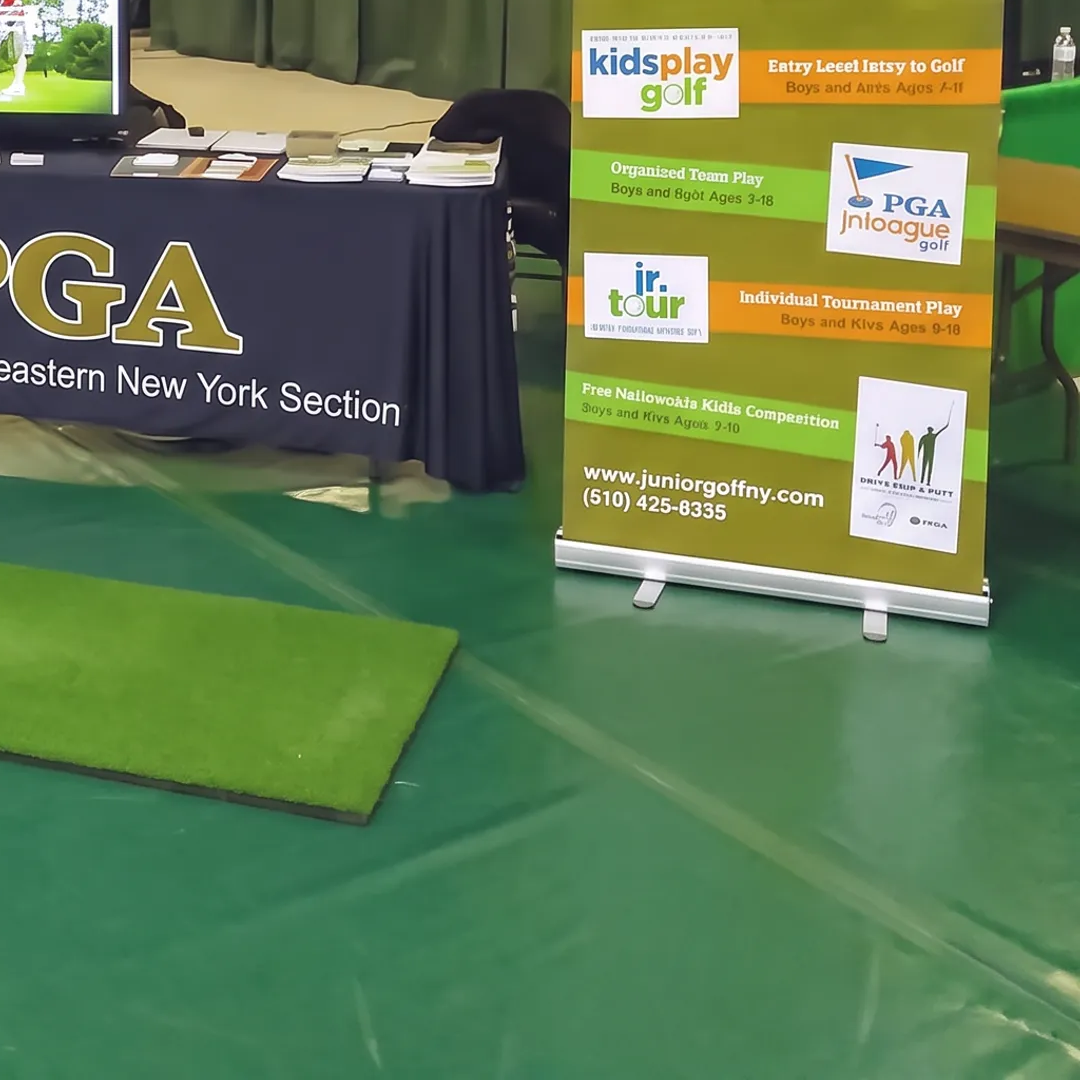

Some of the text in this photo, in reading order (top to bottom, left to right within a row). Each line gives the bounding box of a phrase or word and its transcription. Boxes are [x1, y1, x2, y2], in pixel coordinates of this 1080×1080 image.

[589, 46, 734, 82] kidsplay
[909, 59, 928, 74] to
[930, 57, 967, 74] Golf
[640, 76, 707, 113] golf
[786, 81, 820, 97] Boys
[824, 81, 852, 94] and
[688, 168, 729, 184] Team
[731, 170, 765, 189] Play
[611, 182, 643, 198] Boys
[646, 186, 671, 199] and
[708, 190, 743, 206] Ages
[747, 192, 774, 207] 3-18
[882, 193, 951, 219] PGA
[918, 237, 950, 253] golf
[635, 261, 668, 297] jr.
[608, 288, 686, 320] tour
[739, 290, 963, 319] Individual Tournament Play
[780, 313, 816, 330] Boys
[820, 316, 846, 330] and
[889, 320, 927, 336] Ages
[117, 364, 187, 401] New
[196, 371, 268, 410] York
[278, 380, 401, 427] Section
[581, 382, 612, 399] Free
[616, 408, 639, 421] and
[583, 466, 825, 508] www.juniorgoffny.com
[582, 487, 728, 522] (510) 425-8335
